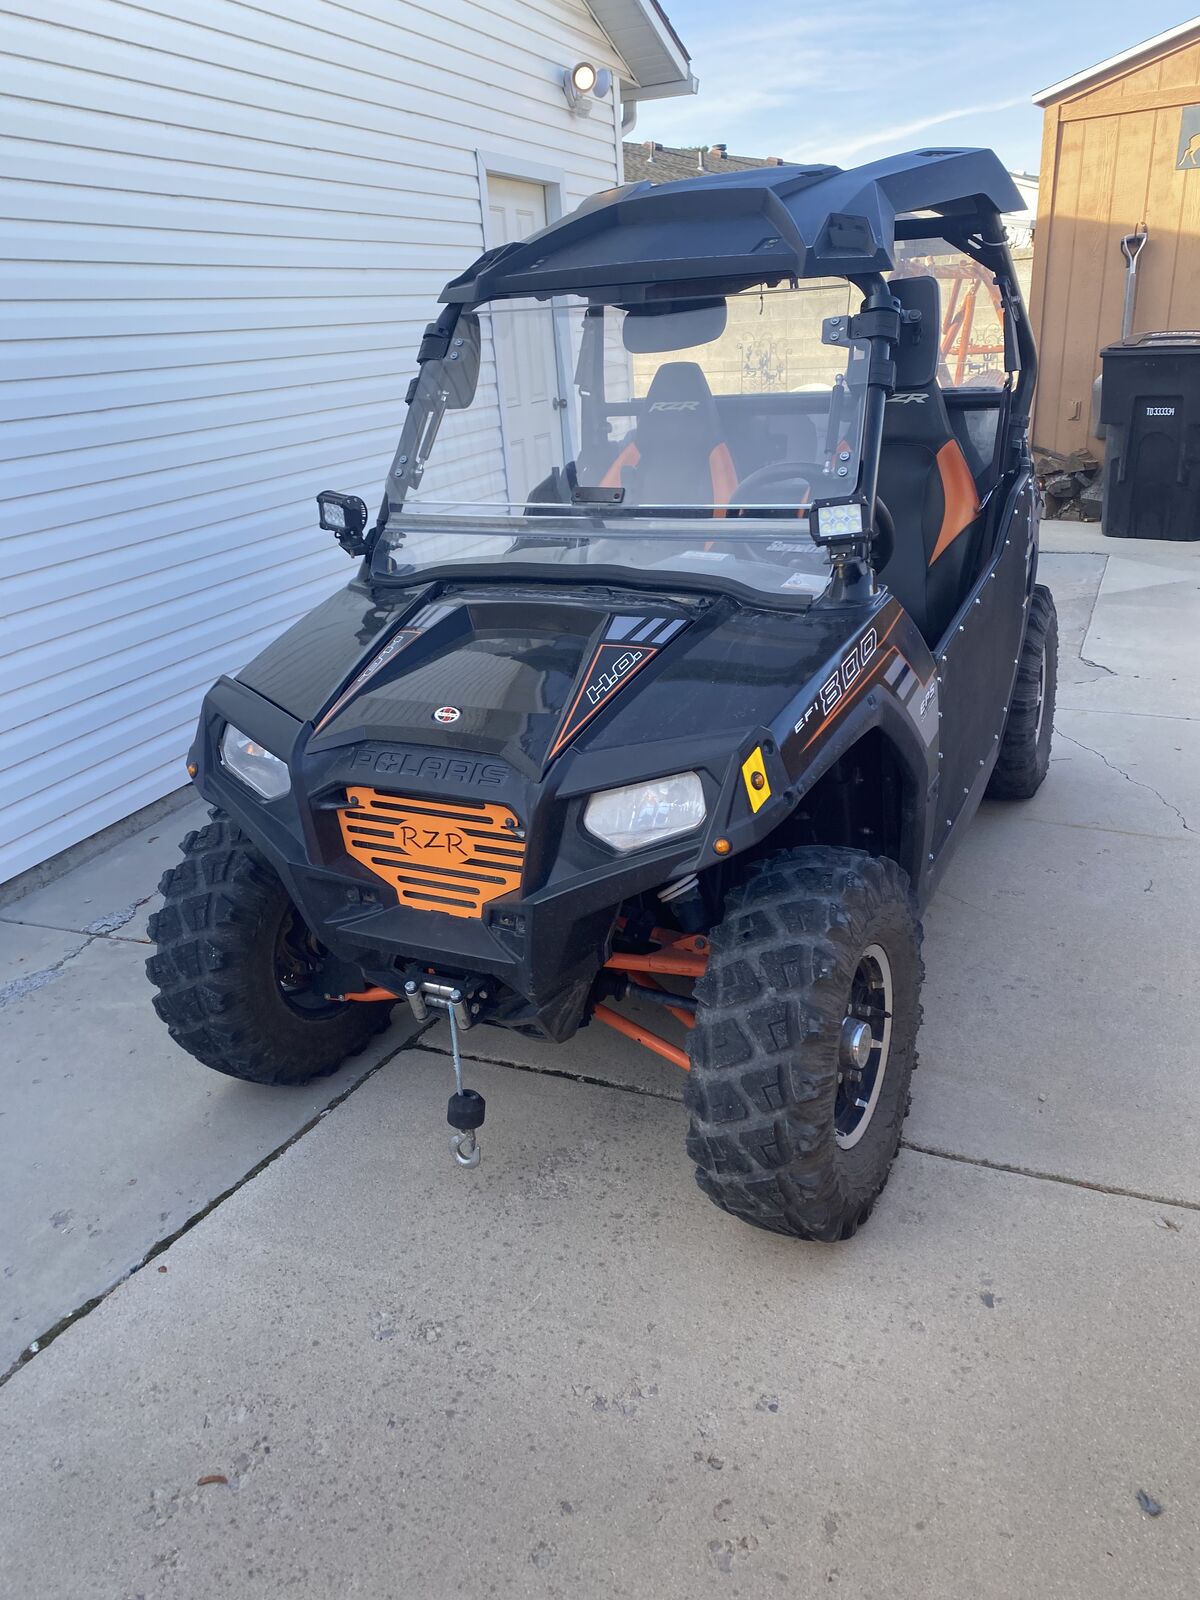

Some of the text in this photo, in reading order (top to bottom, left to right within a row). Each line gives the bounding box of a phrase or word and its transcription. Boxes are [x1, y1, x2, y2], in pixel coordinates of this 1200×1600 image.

[648, 401, 700, 413] RZR
[884, 393, 930, 404] ZR
[586, 651, 643, 705] H.O.
[794, 627, 878, 734] EFI 800
[350, 749, 510, 789] POLARIS
[400, 825, 469, 857] RZR
